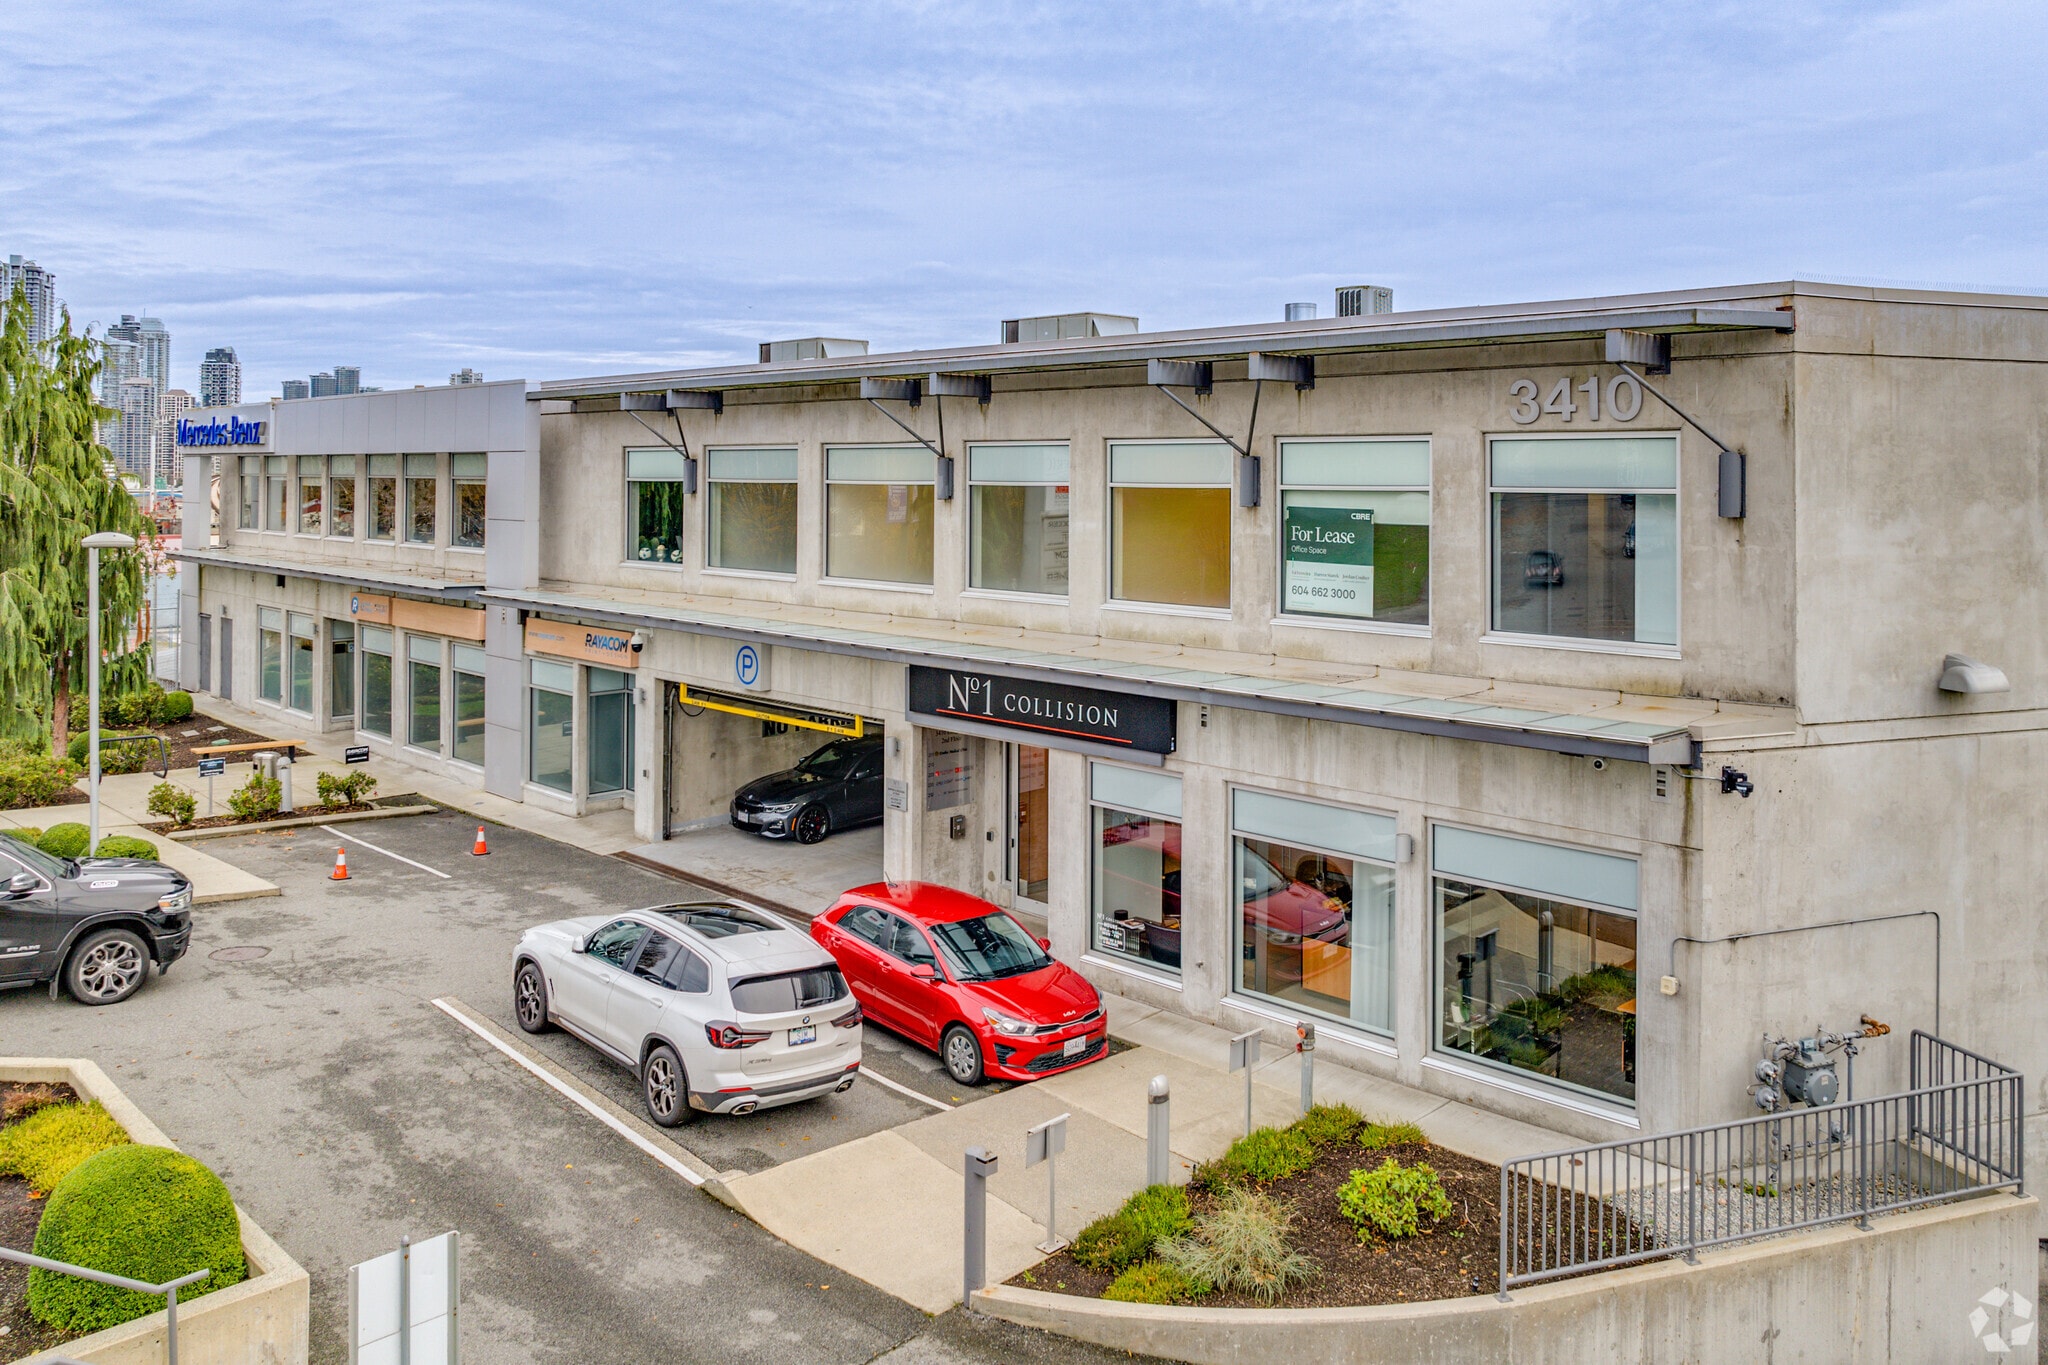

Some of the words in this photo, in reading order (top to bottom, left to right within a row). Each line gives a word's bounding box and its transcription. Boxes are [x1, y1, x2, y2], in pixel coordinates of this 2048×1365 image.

[1509, 374, 1642, 424] 3410
[177, 415, 262, 446] Mercedes-Benz
[1291, 525, 1313, 541] For
[1315, 526, 1356, 544] Lease
[1291, 545, 1308, 553] Office
[1308, 546, 1327, 555] Space
[1291, 585, 1309, 595] 604
[1311, 586, 1328, 598] 662
[1330, 588, 1356, 600] 3000
[585, 633, 629, 653] RAYACOM
[742, 654, 753, 678] P
[1004, 693, 1119, 728] COLLISION
